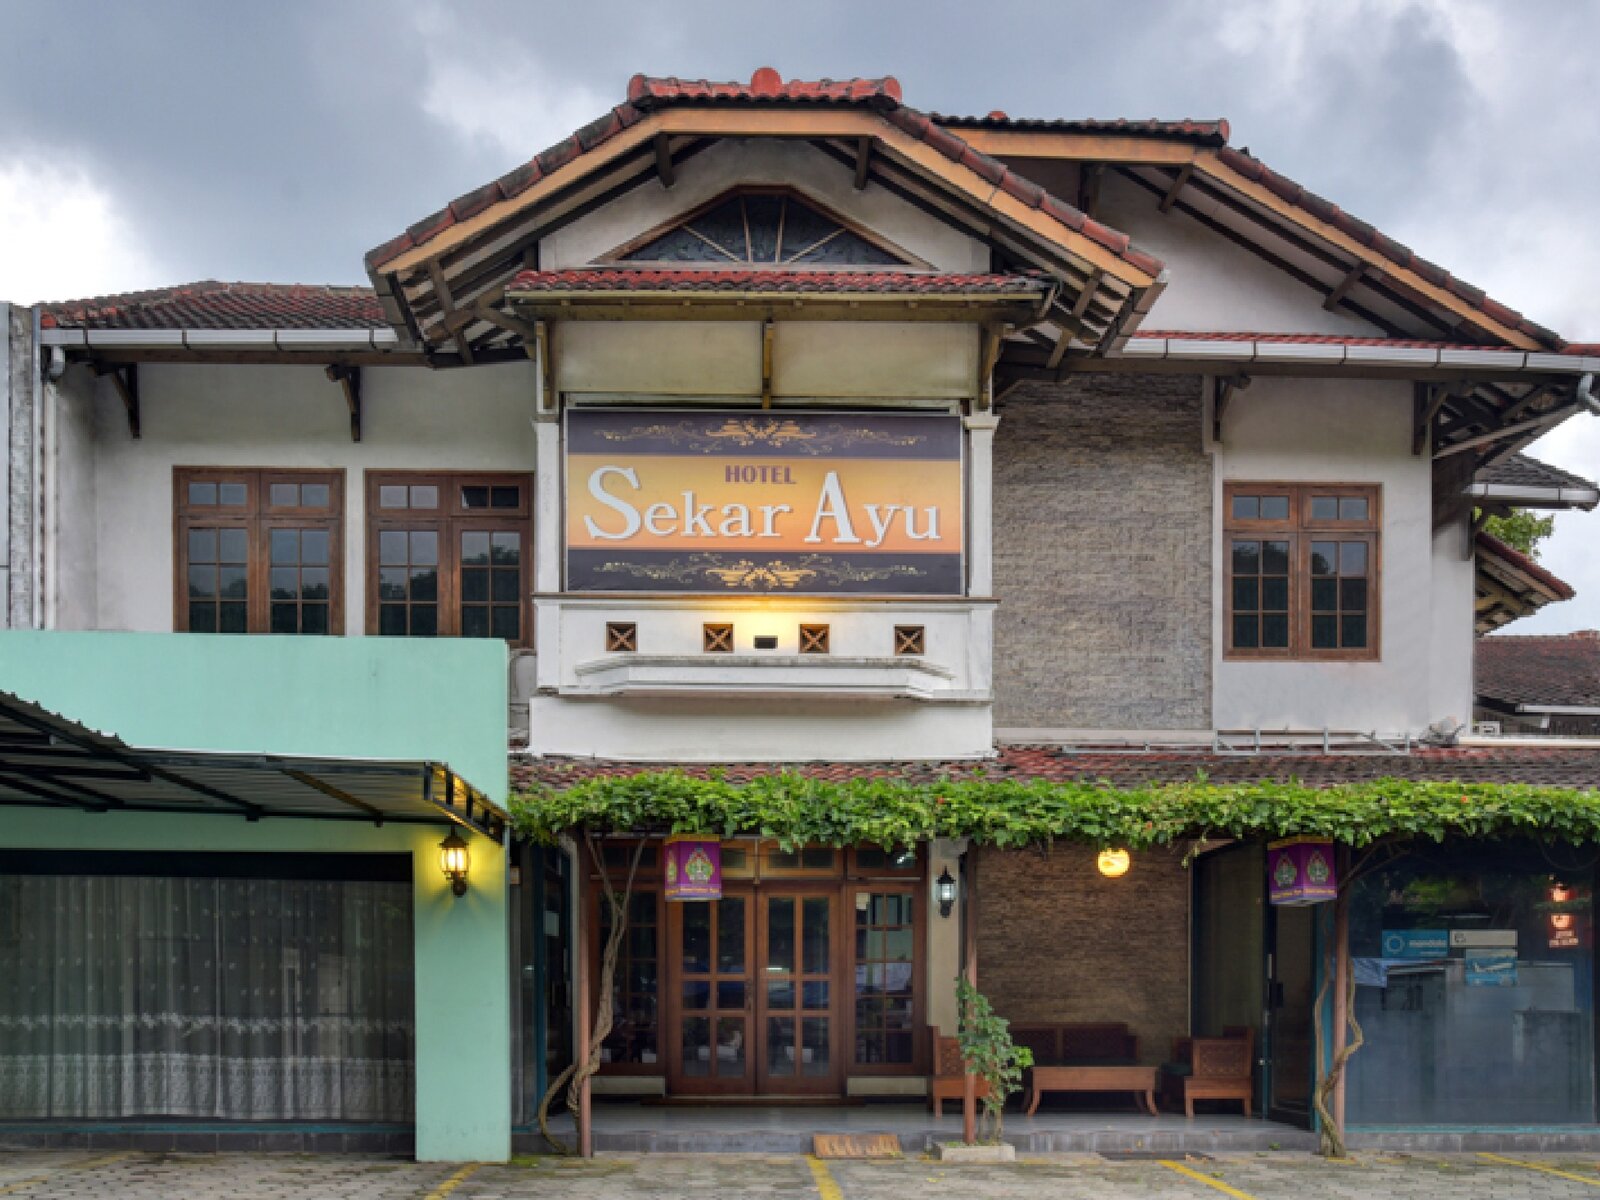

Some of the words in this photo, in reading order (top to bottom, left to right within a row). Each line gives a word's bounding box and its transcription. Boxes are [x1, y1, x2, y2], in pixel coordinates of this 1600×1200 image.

[725, 464, 796, 484] HOTEL
[583, 465, 793, 540] Sekar
[804, 470, 942, 547] Ayu
